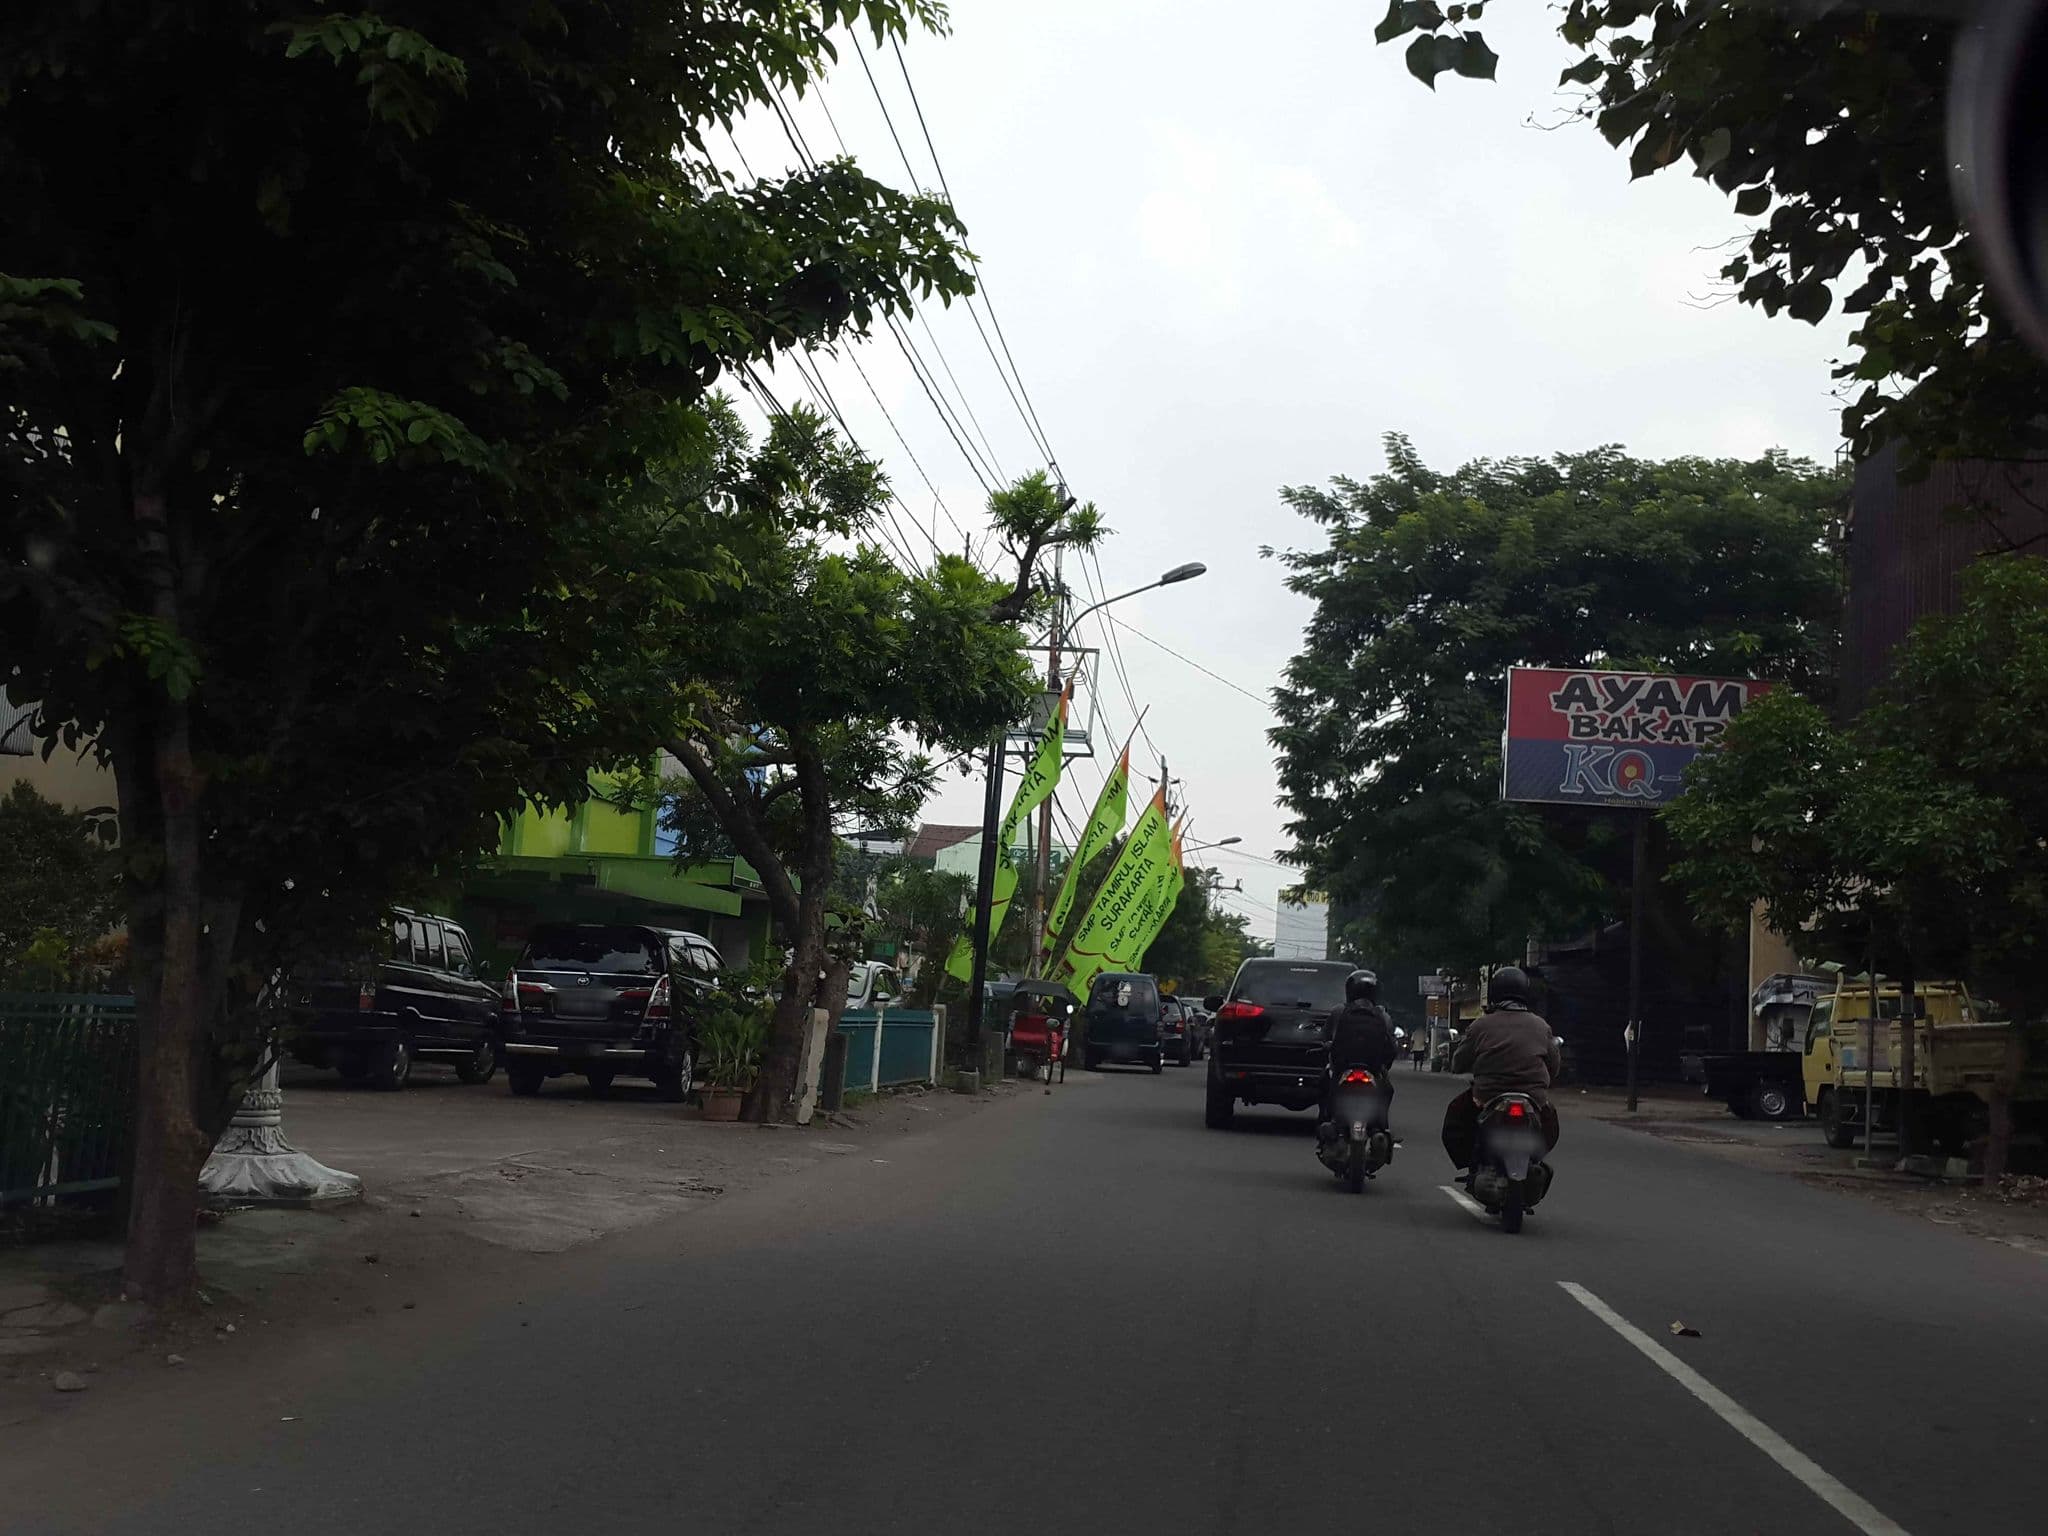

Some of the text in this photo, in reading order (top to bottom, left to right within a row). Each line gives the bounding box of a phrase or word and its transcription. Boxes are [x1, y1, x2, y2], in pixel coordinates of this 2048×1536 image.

[1550, 674, 1747, 719] AYAM
[1569, 713, 1727, 745] BAKAR
[1078, 913, 1096, 942] SMP
[1130, 816, 1159, 860] ISLAM
[1101, 858, 1155, 931] SURAKARTA
